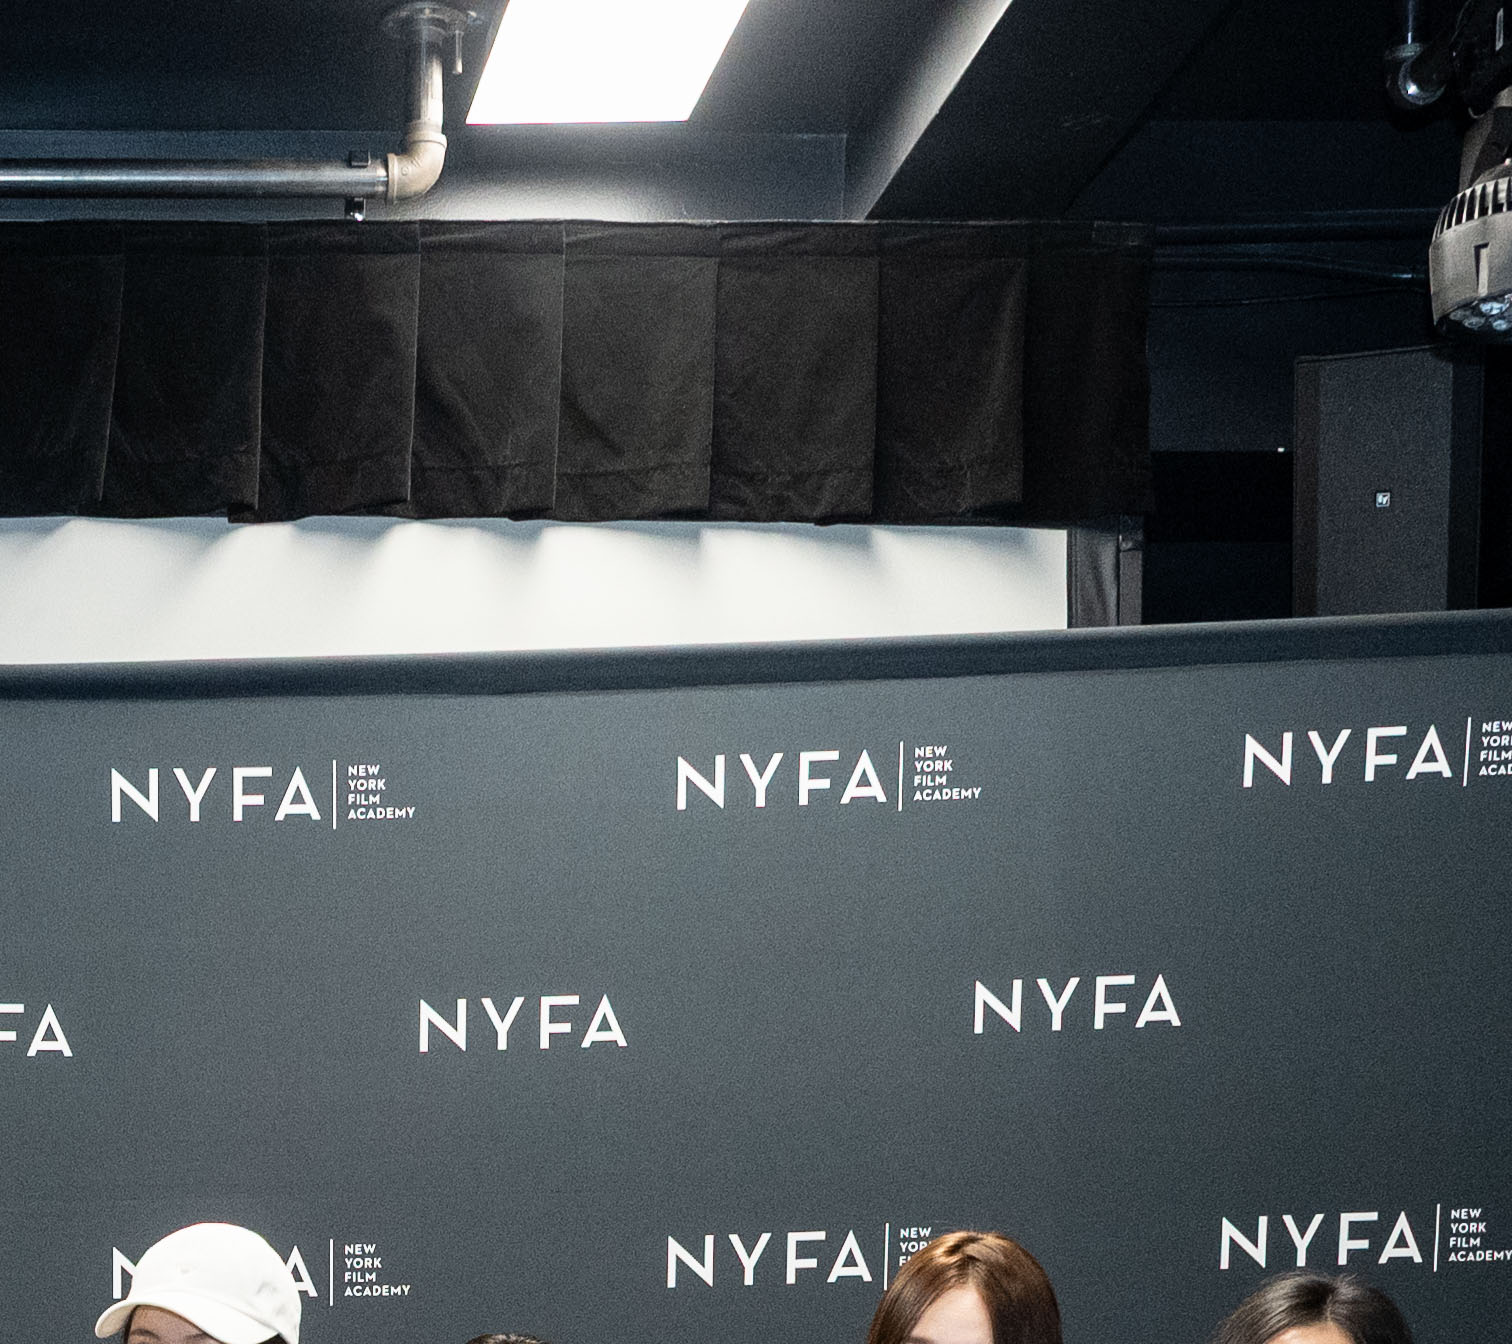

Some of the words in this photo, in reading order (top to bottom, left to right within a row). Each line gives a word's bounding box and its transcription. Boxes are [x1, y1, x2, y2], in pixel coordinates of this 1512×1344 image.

[914, 745, 947, 758] NEW
[1243, 724, 1452, 788] NYFA
[1479, 750, 1512, 762] FILM
[348, 764, 380, 777] NEW
[914, 759, 953, 772] YORK
[348, 778, 386, 791] YORK
[676, 749, 887, 811] NYFA
[913, 774, 947, 787] FILM
[111, 766, 321, 823] NYFA
[348, 793, 380, 805] FILM
[913, 787, 982, 801] ACADEMY
[347, 806, 416, 820] ACADEMY
[973, 974, 1181, 1034] NYFA
[419, 994, 628, 1053] NYFA
[1450, 1208, 1482, 1220] NEW
[899, 1226, 932, 1239] NEW
[1450, 1222, 1486, 1234] YORK
[899, 1240, 932, 1253] YOR
[1219, 1211, 1423, 1270] NYFA
[1449, 1236, 1481, 1248] FILM
[344, 1243, 376, 1255] NEW
[1448, 1249, 1512, 1262] ACADEMY
[344, 1257, 382, 1269] YORK
[667, 1230, 873, 1289] NYFA
[112, 1245, 318, 1300] NA
[344, 1271, 377, 1283] FILM
[344, 1284, 411, 1297] ACADEMY
